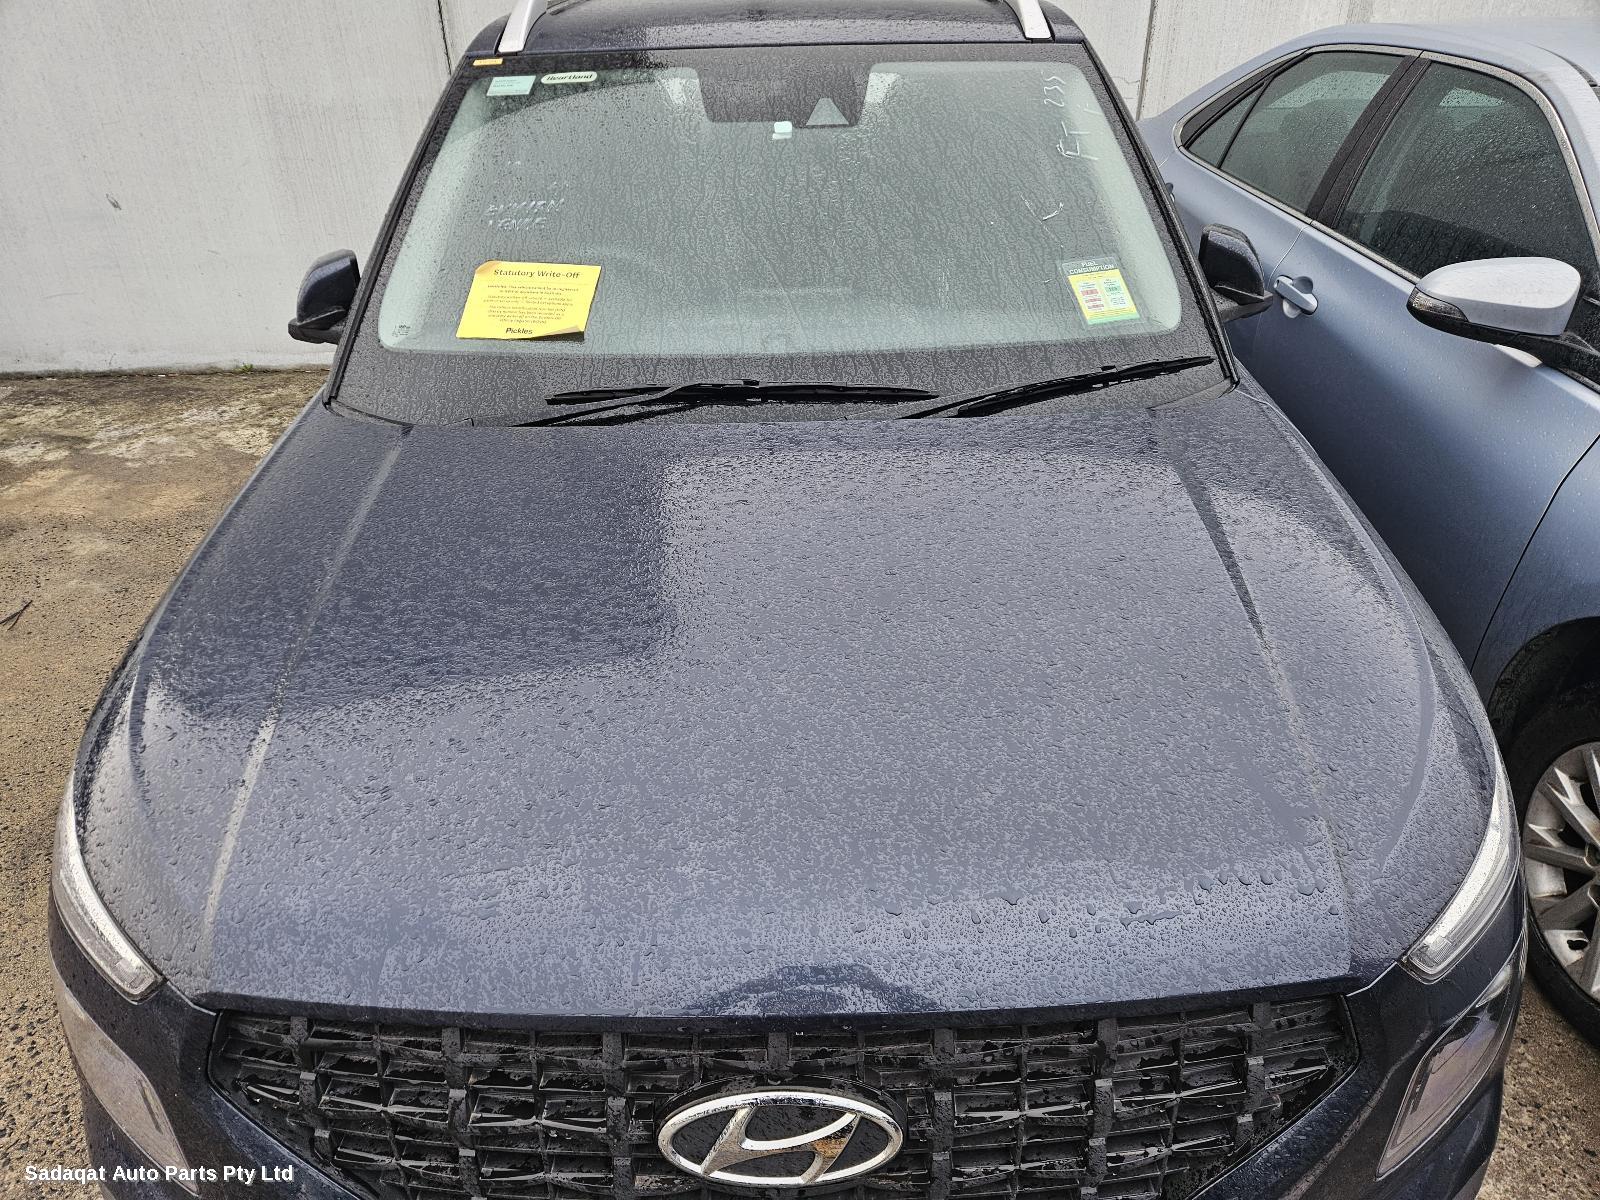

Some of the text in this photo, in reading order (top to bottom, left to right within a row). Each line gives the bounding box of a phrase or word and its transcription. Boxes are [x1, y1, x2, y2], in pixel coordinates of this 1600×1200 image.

[494, 269, 582, 279] Statutory Write-Off
[1069, 264, 1115, 275] CONSUMPTION
[505, 327, 533, 335] Pickles
